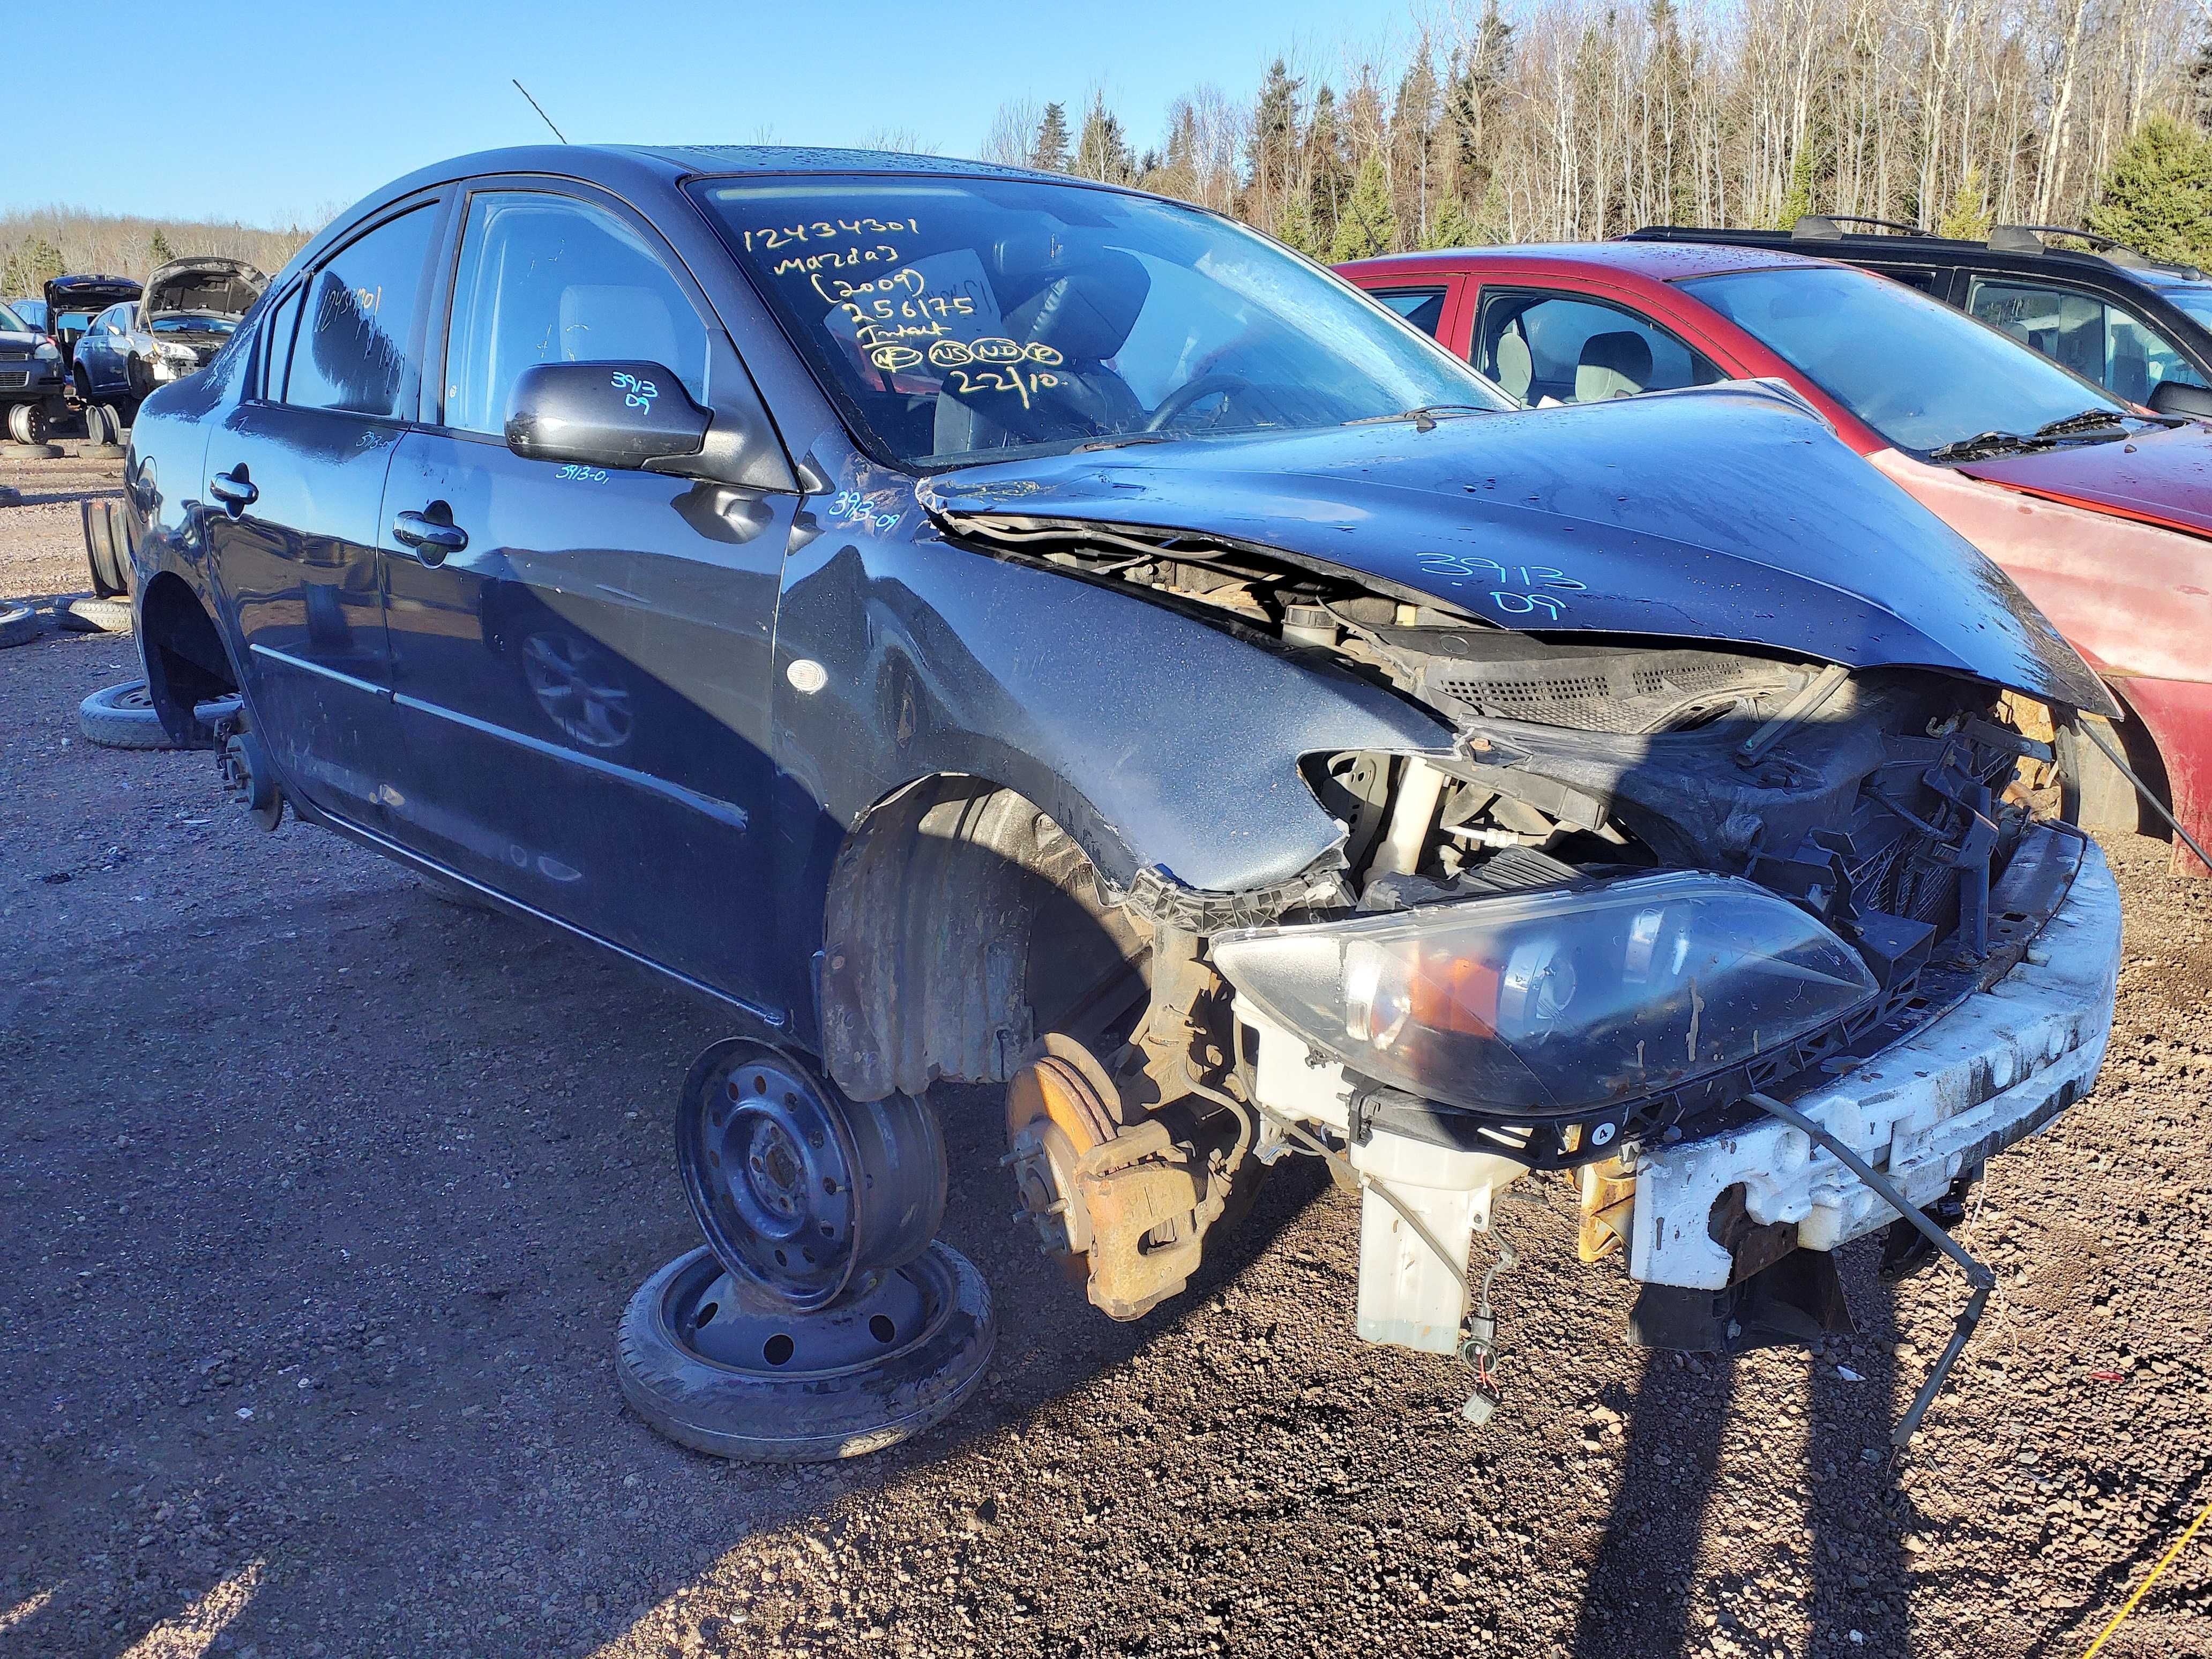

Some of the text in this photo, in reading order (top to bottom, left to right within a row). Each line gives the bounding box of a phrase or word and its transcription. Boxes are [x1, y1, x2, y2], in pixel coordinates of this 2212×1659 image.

[743, 218, 919, 252] 12434301
[841, 296, 974, 323] 256175
[611, 371, 658, 398] 3913
[625, 393, 650, 415] 09
[828, 491, 900, 532] 3913-09
[1416, 552, 1587, 590] 3913
[1489, 591, 1567, 621] 09
[1599, 1129, 1608, 1139] 4
